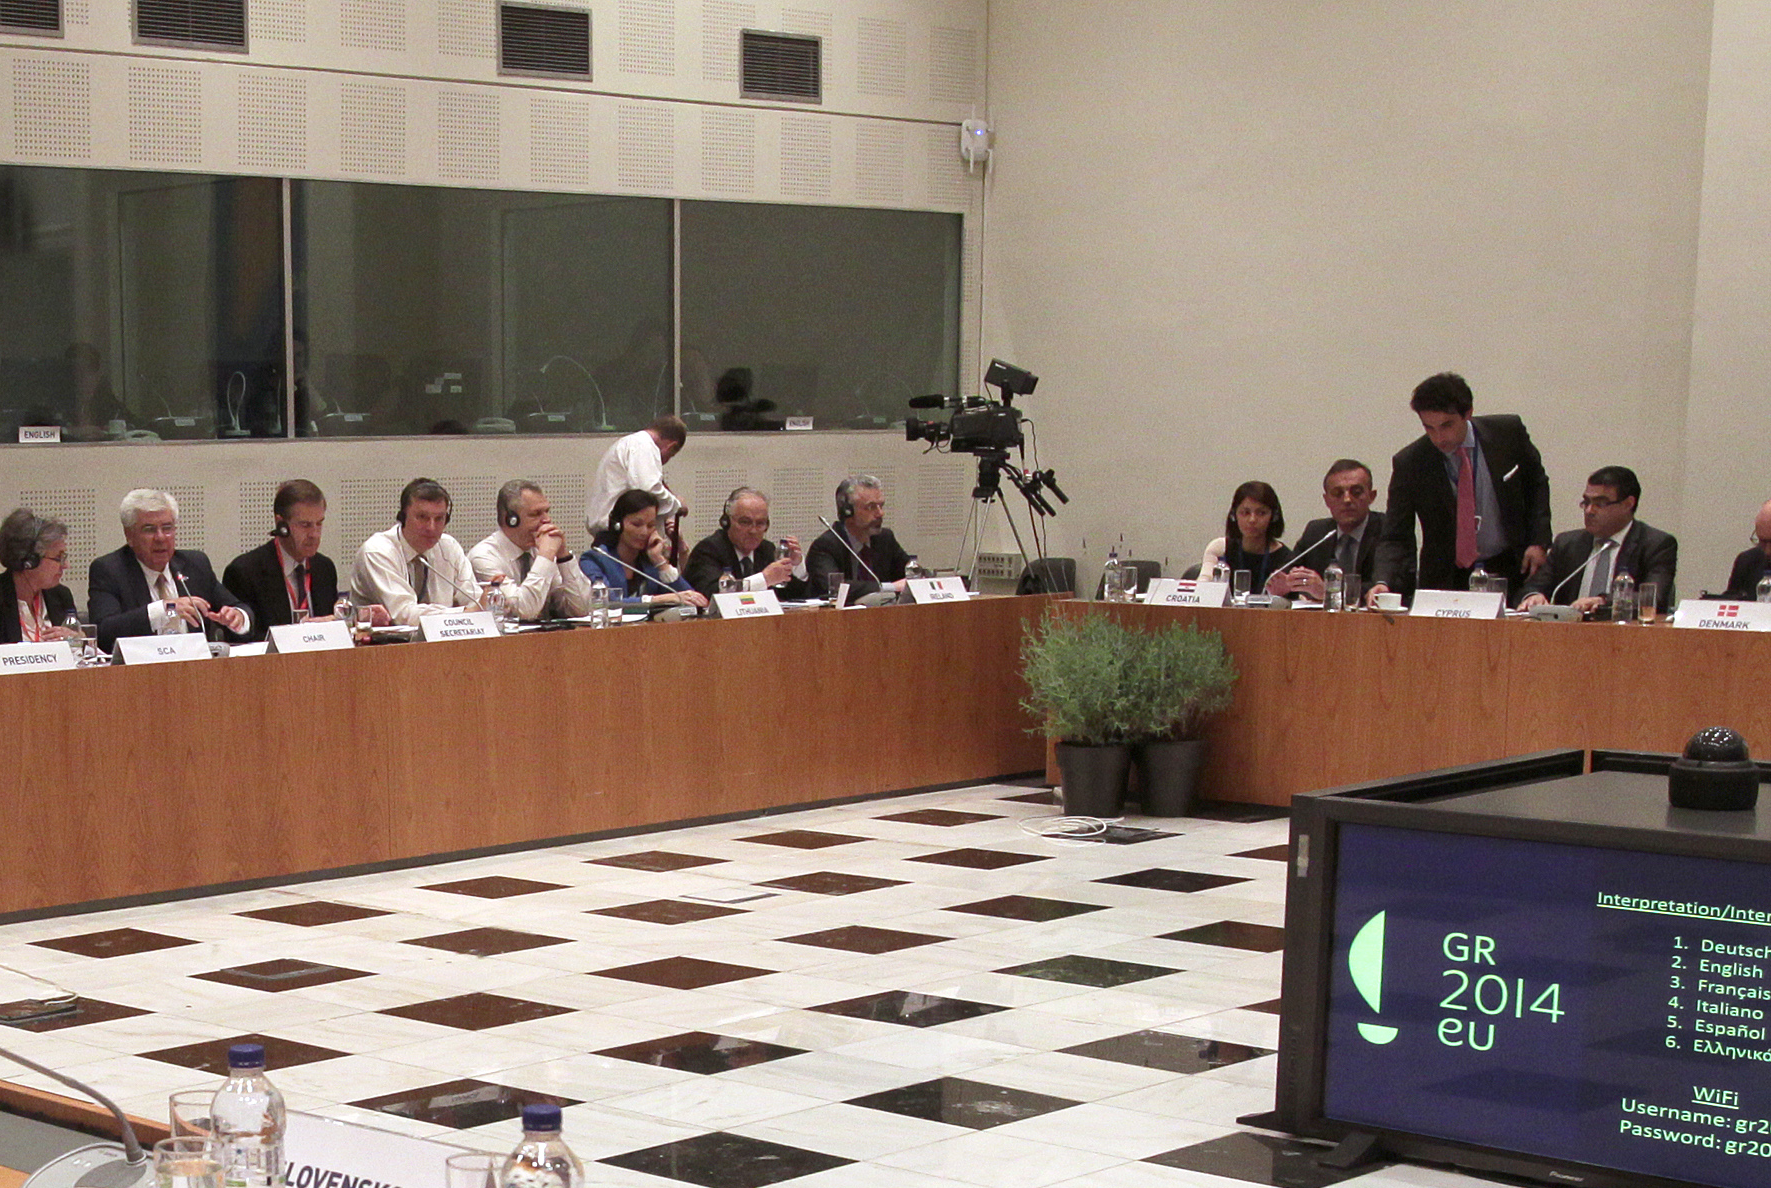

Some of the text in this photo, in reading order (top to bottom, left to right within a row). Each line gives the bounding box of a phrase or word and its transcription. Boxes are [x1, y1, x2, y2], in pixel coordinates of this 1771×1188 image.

[24, 430, 56, 438] ENGLISH
[1166, 594, 1200, 604] CROATIA
[735, 606, 769, 616] LITHUANIA
[1435, 609, 1471, 618] CYPRUS
[443, 618, 474, 627] COUNCIL
[1698, 619, 1751, 630] DENMARK
[302, 634, 326, 643] CHAIR
[440, 628, 485, 638] SECRETARIAT
[2, 653, 58, 667] PRESIDENCY
[157, 646, 177, 656] SCA
[1441, 931, 1496, 966] GR
[1673, 936, 1771, 960] 1. Deutsch
[1671, 955, 1763, 979] 2. English
[1439, 969, 1566, 1024] 2014
[1670, 975, 1771, 1001] 3. Français
[1668, 996, 1764, 1020] 4. Italiano
[1437, 1017, 1495, 1051] eu
[1667, 1015, 1766, 1040] 5. Español
[1665, 1035, 1681, 1049] 6.
[1692, 1085, 1740, 1108] WiFi
[1620, 1097, 1771, 1135] Username: gr2
[1620, 1119, 1721, 1150] Password:
